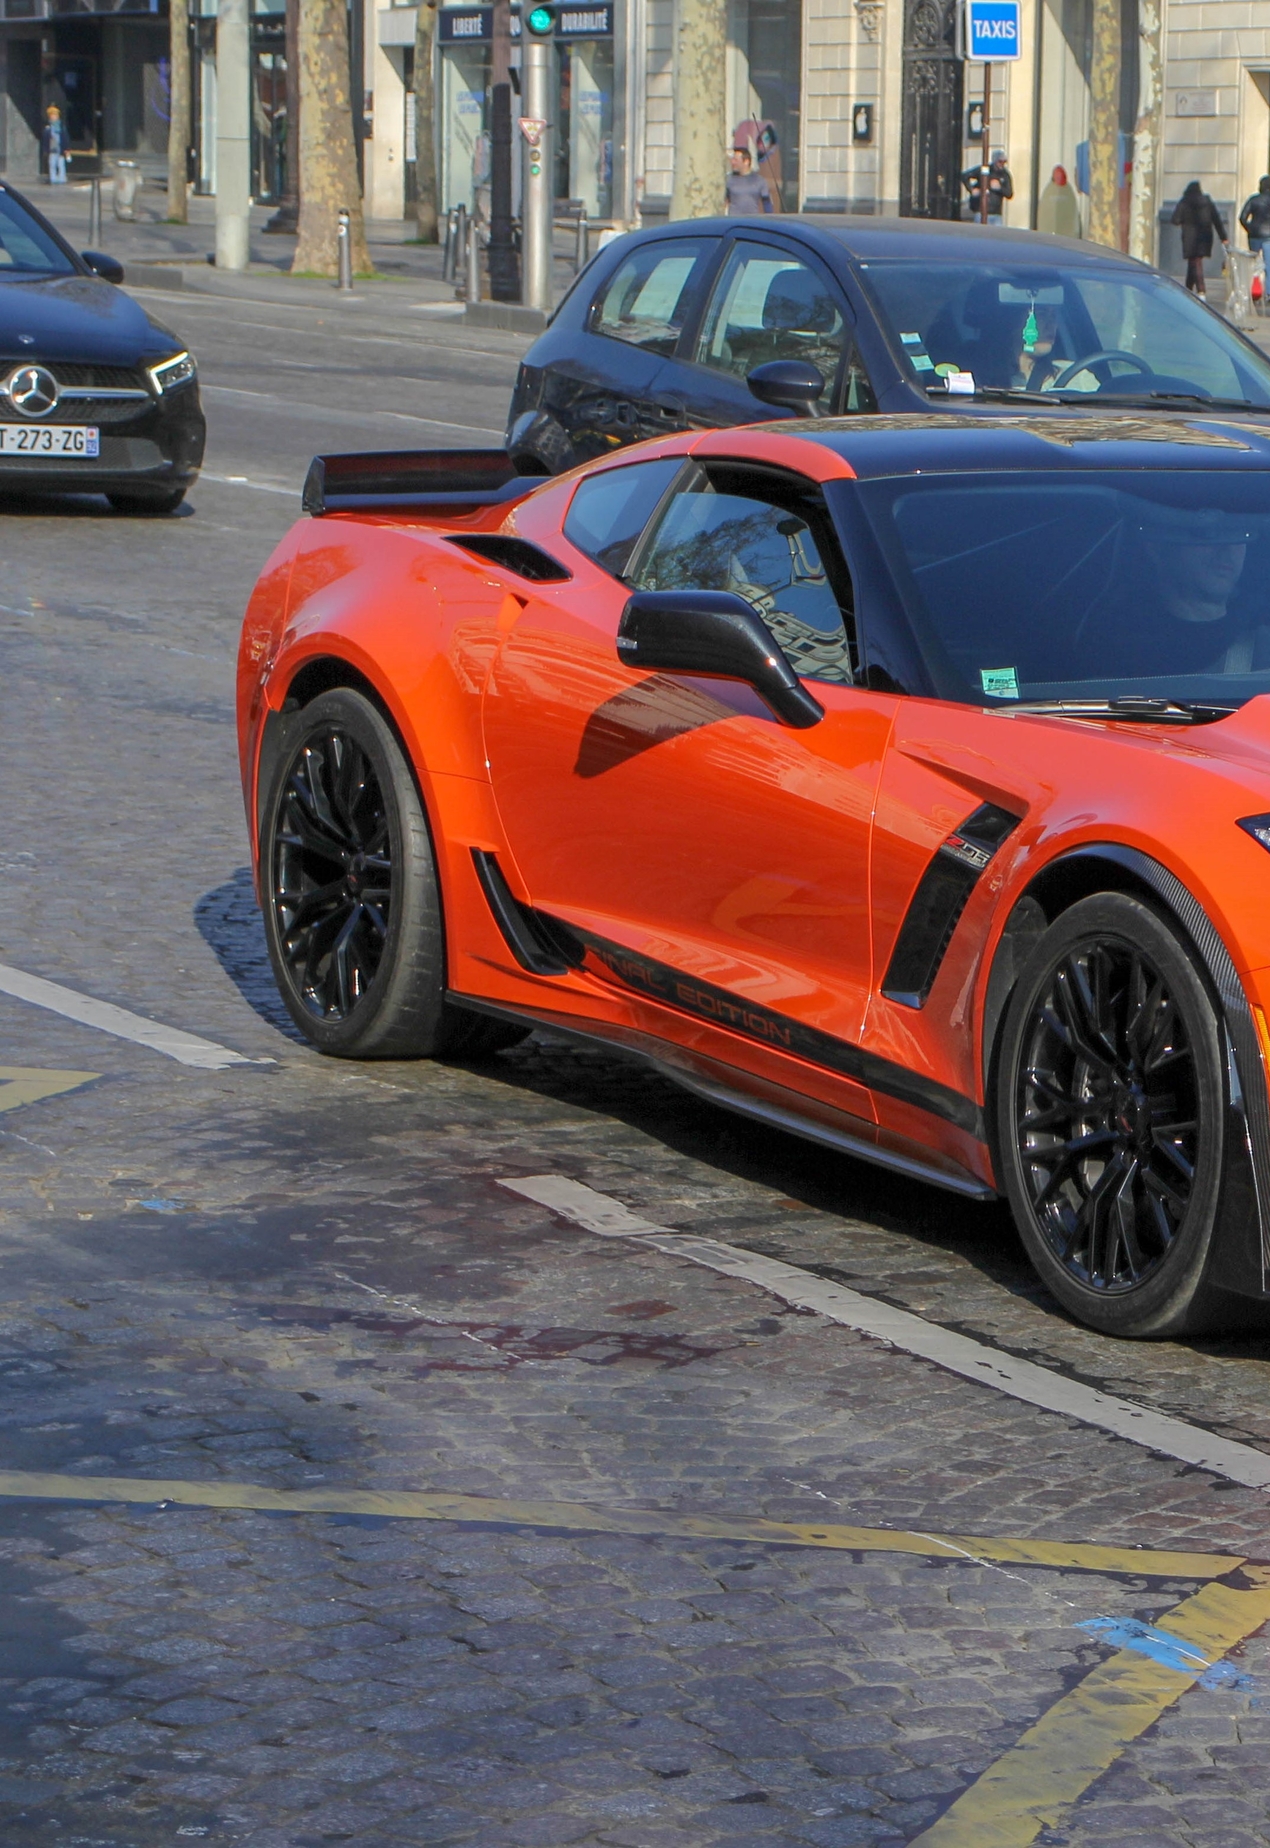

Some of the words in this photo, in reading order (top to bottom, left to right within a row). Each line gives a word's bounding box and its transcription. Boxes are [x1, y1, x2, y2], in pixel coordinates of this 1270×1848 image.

[452, 13, 483, 37] LIBERTÉ
[561, 8, 609, 33] DURABILITÉ
[973, 19, 1016, 39] TAXIS
[676, 982, 792, 1045] EDITION
